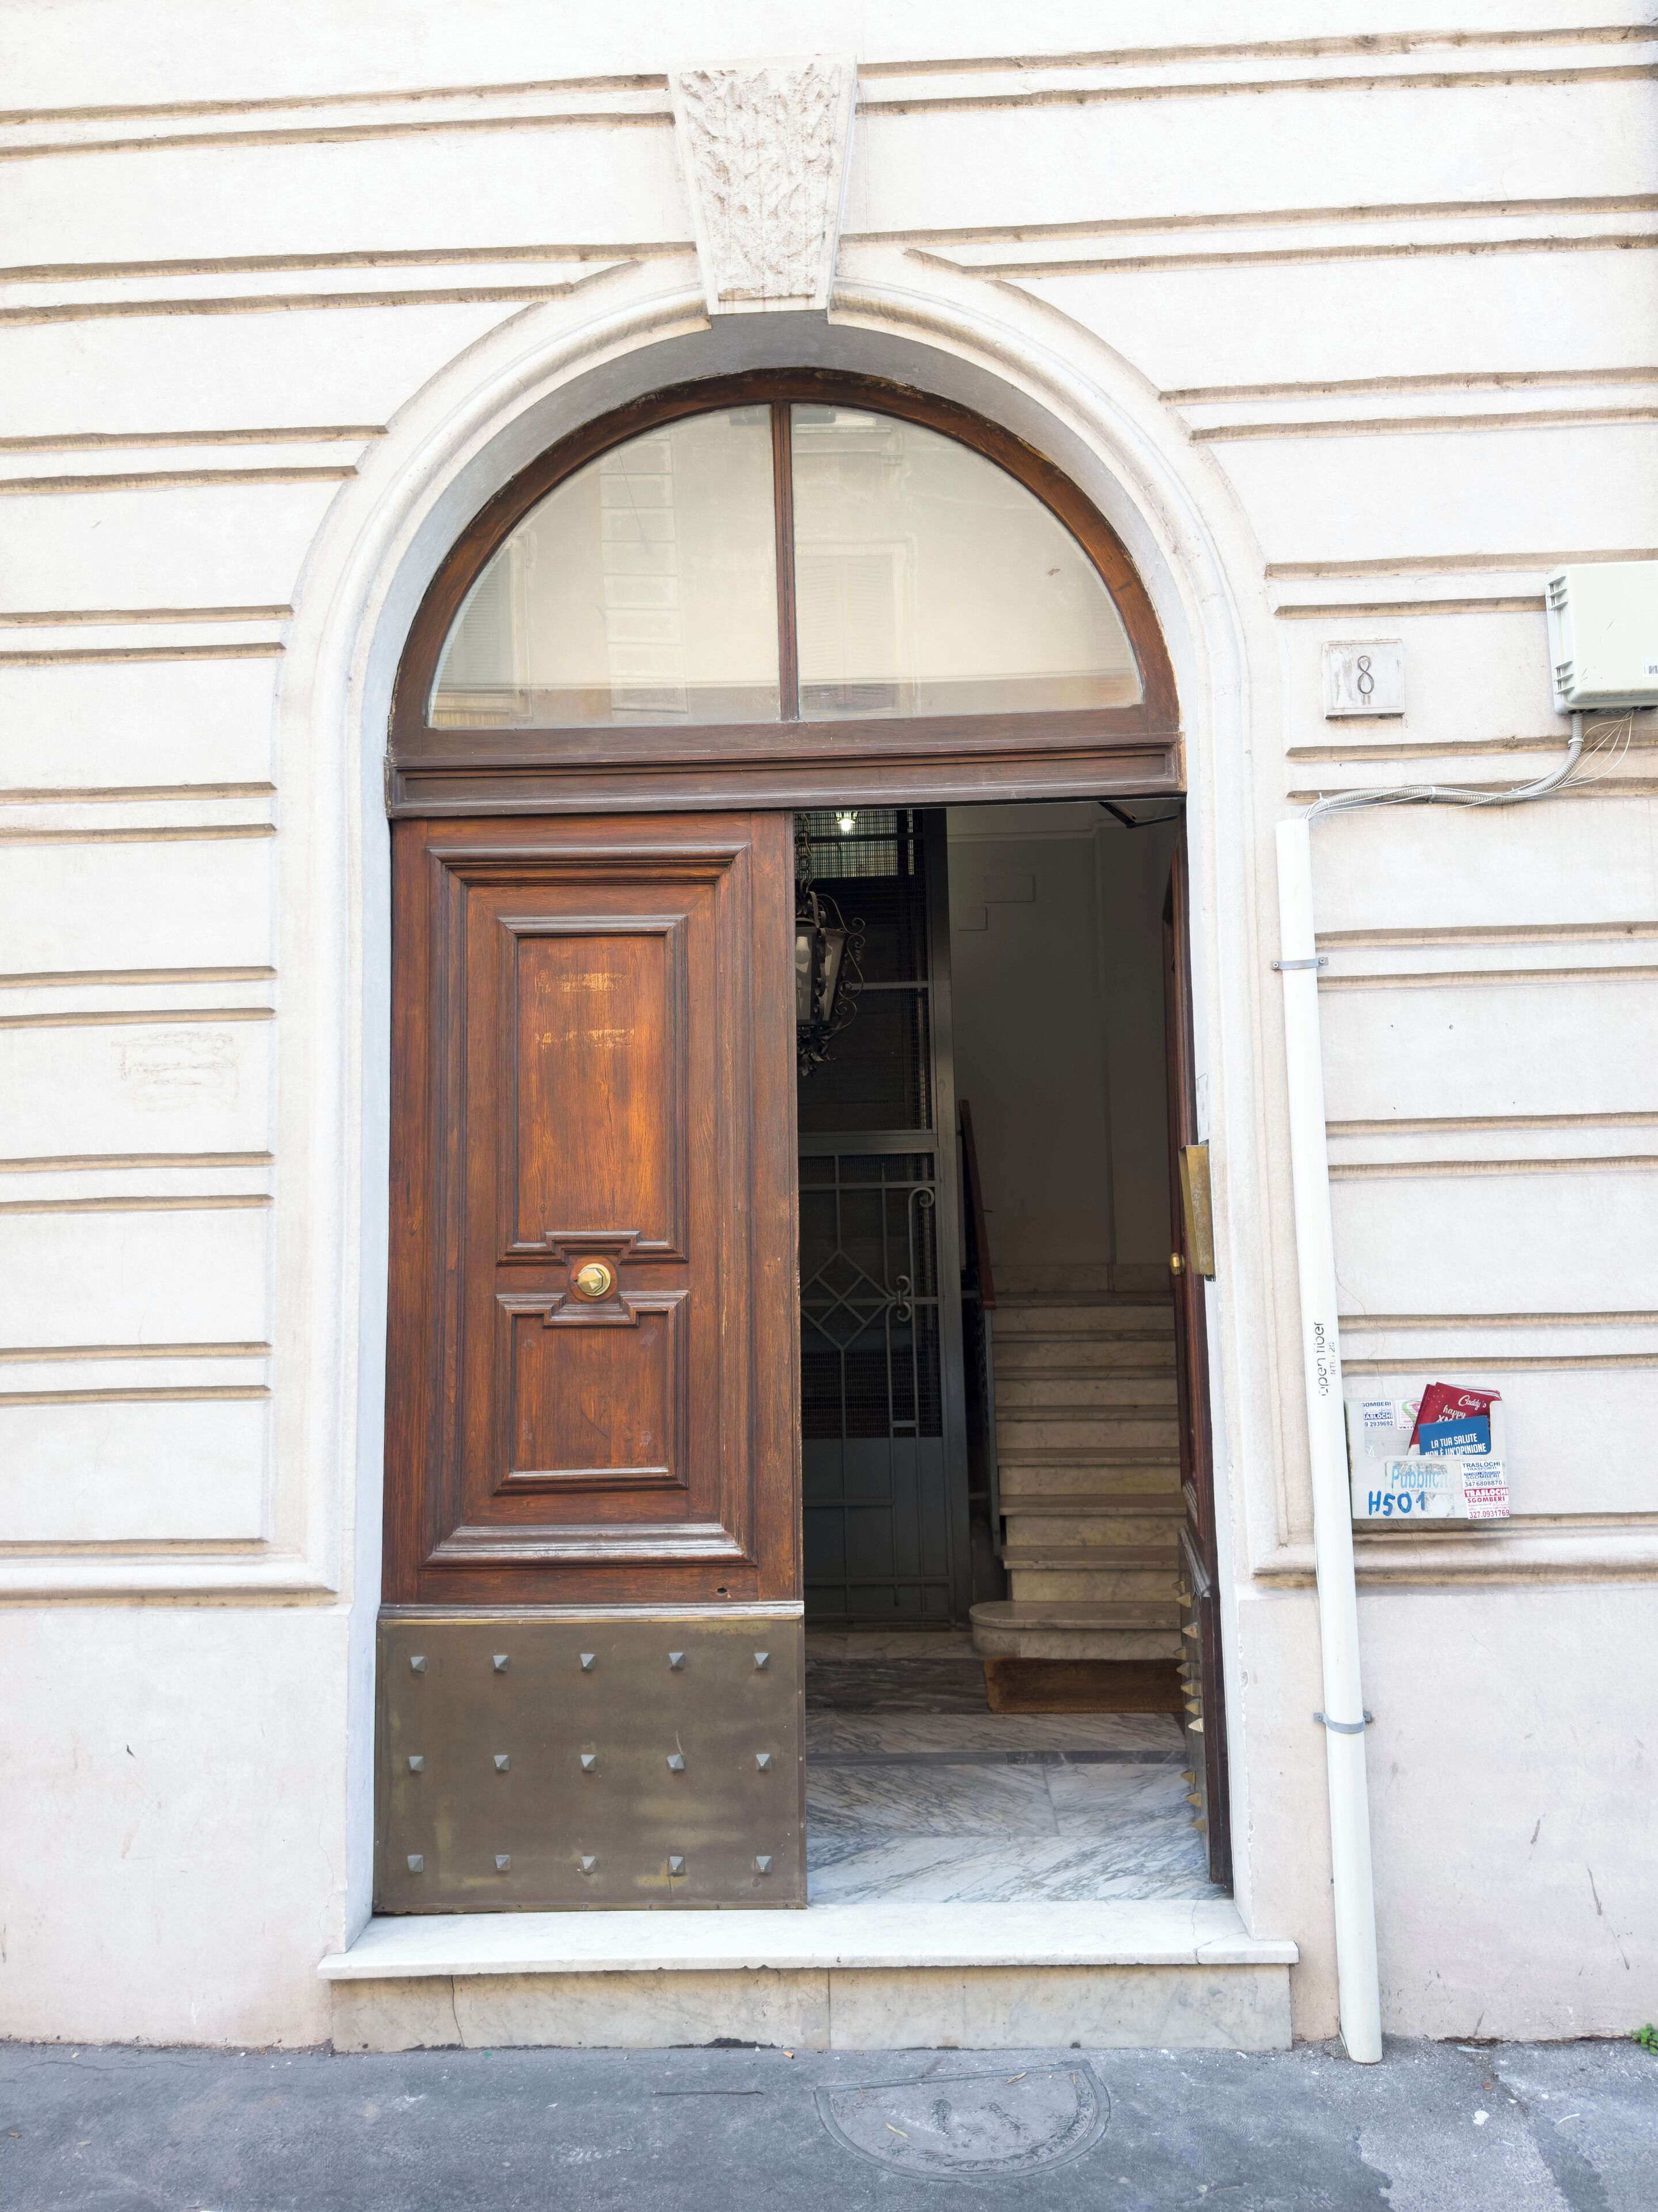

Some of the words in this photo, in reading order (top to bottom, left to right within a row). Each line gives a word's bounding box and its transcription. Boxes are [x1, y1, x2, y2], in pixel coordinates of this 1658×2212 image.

[1357, 656, 1375, 694] 8
[1458, 1395, 1486, 1410] Caddy's
[1443, 1405, 1466, 1419] happy
[1431, 1440, 1439, 1449] LA
[1440, 1437, 1452, 1447] TUA
[1454, 1433, 1477, 1445] SALUTE
[1445, 1443, 1486, 1456] UN'OPINIONE
[1465, 1488, 1509, 1497] TRASLOCHI
